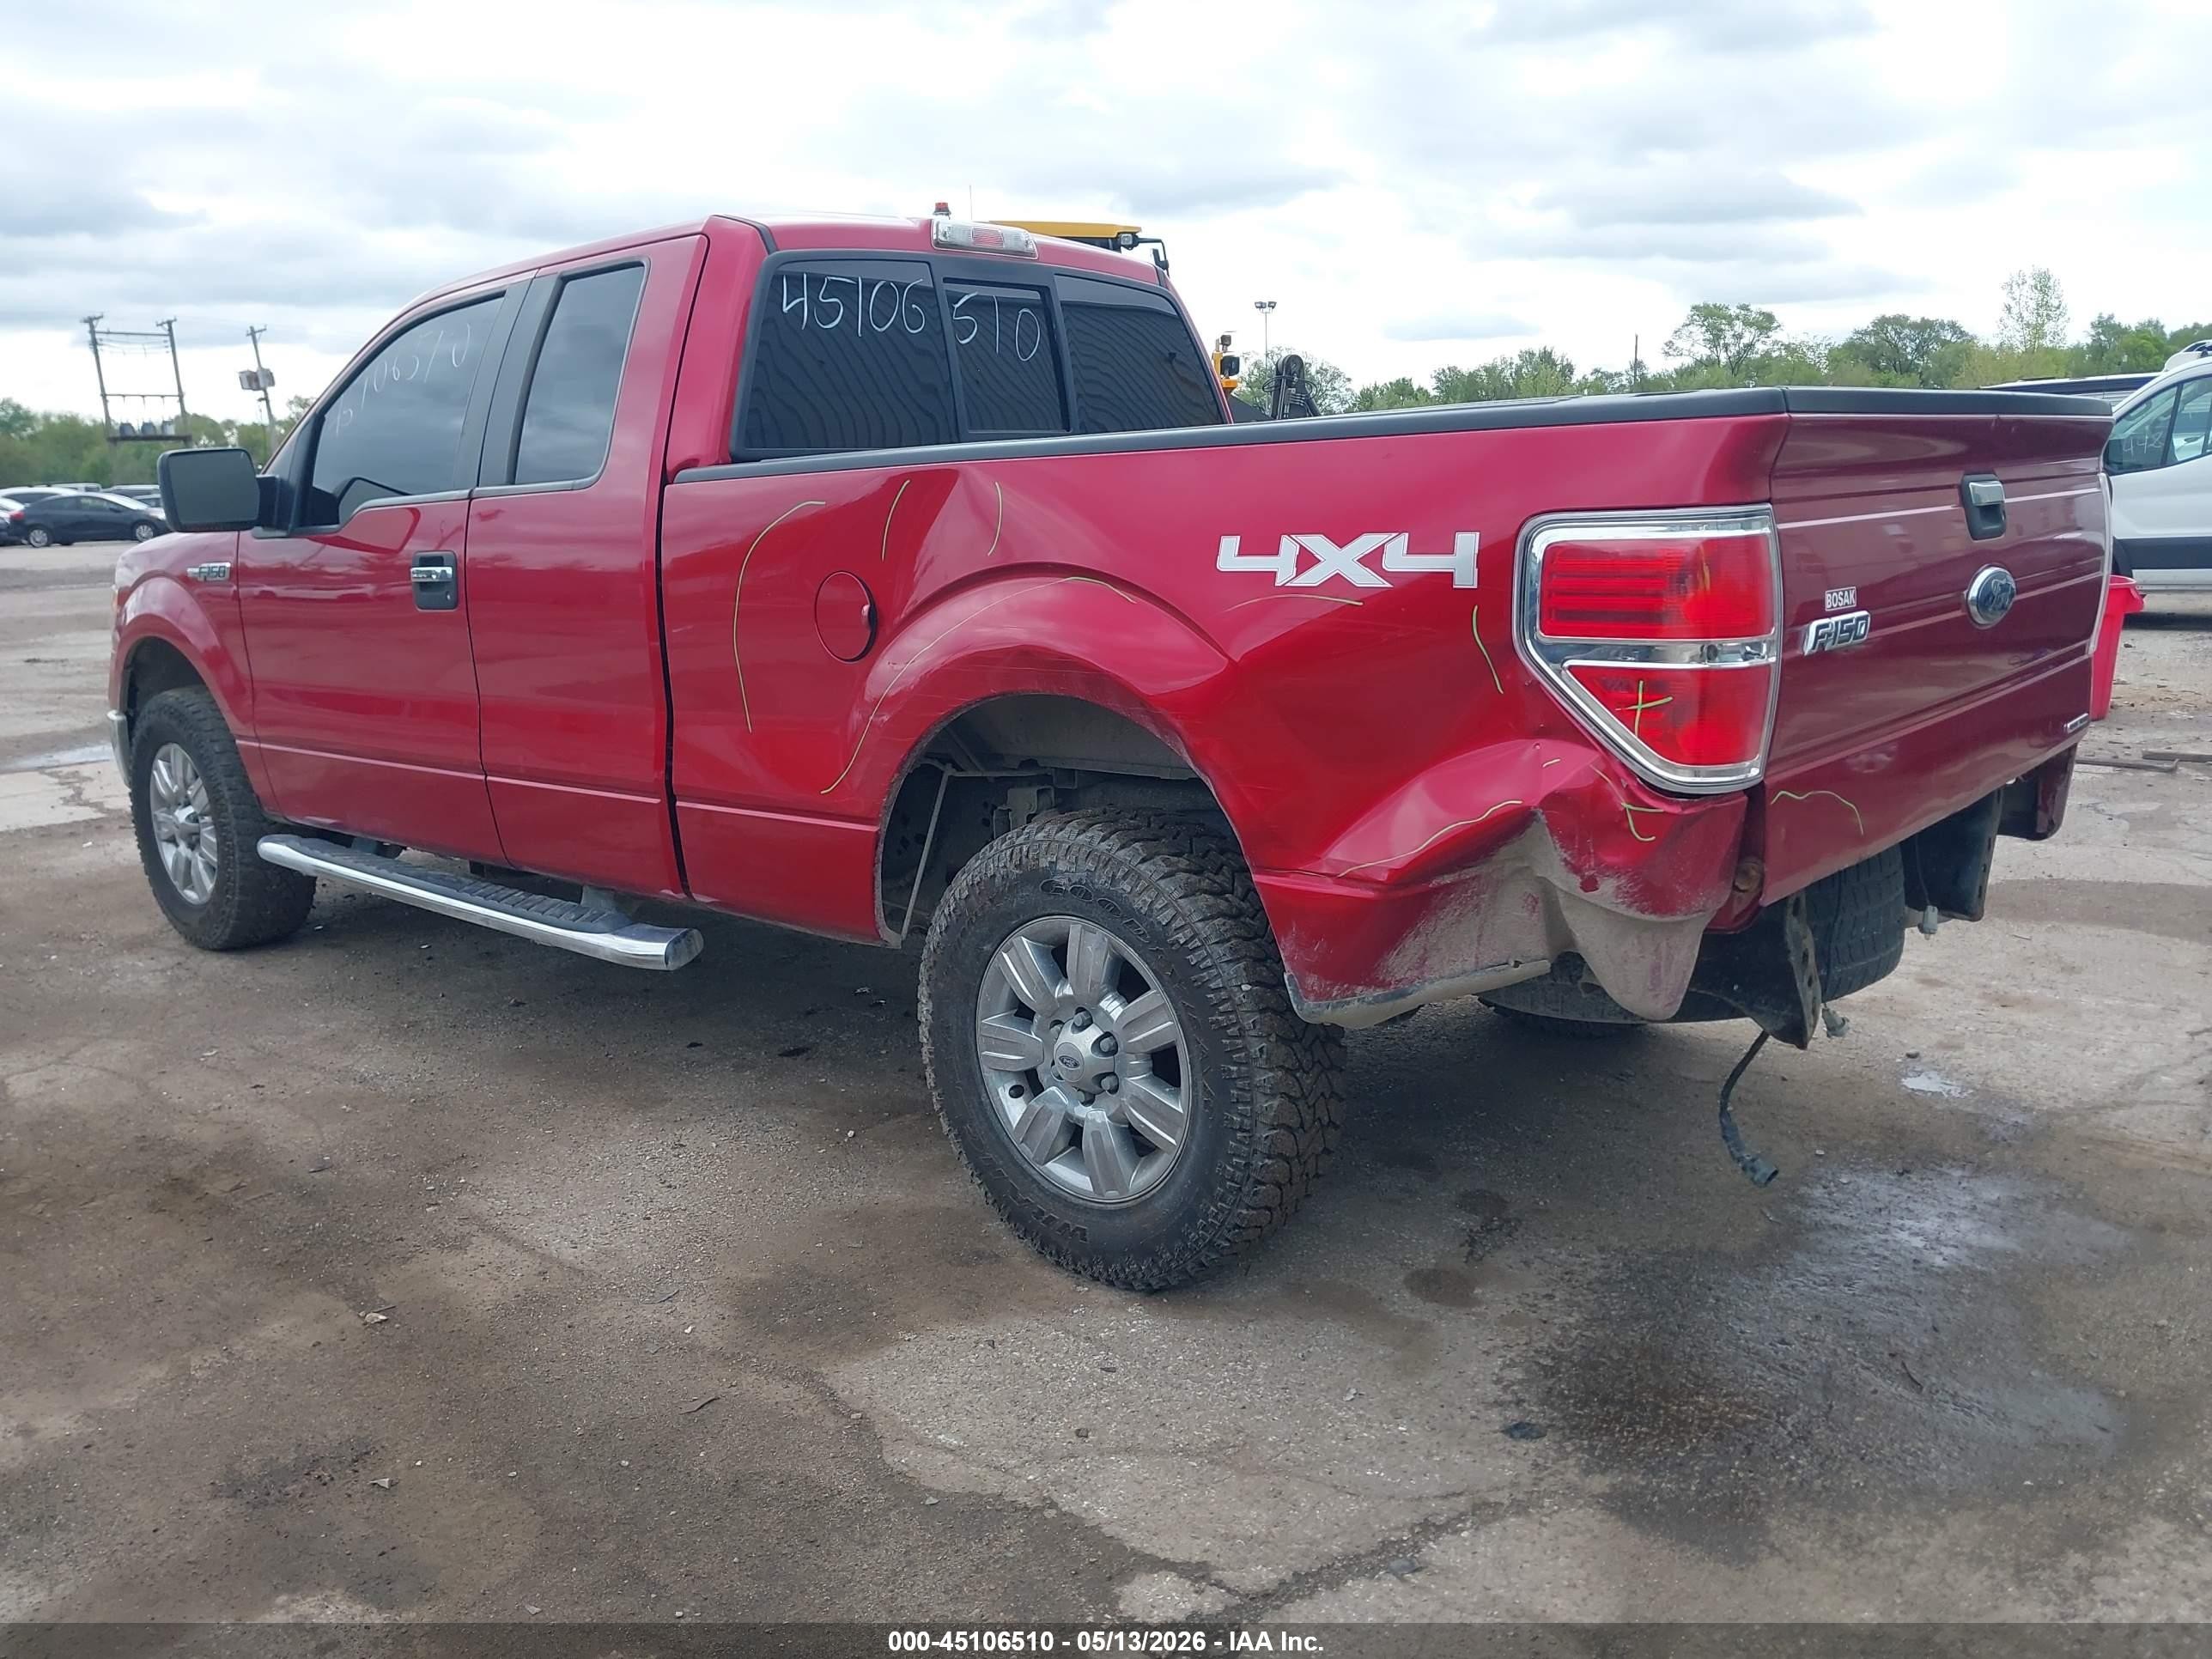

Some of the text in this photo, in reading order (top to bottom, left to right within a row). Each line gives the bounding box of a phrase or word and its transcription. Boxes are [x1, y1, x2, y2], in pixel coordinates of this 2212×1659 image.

[783, 273, 1041, 362] 45106 510
[1826, 590, 1856, 609] BOSAK
